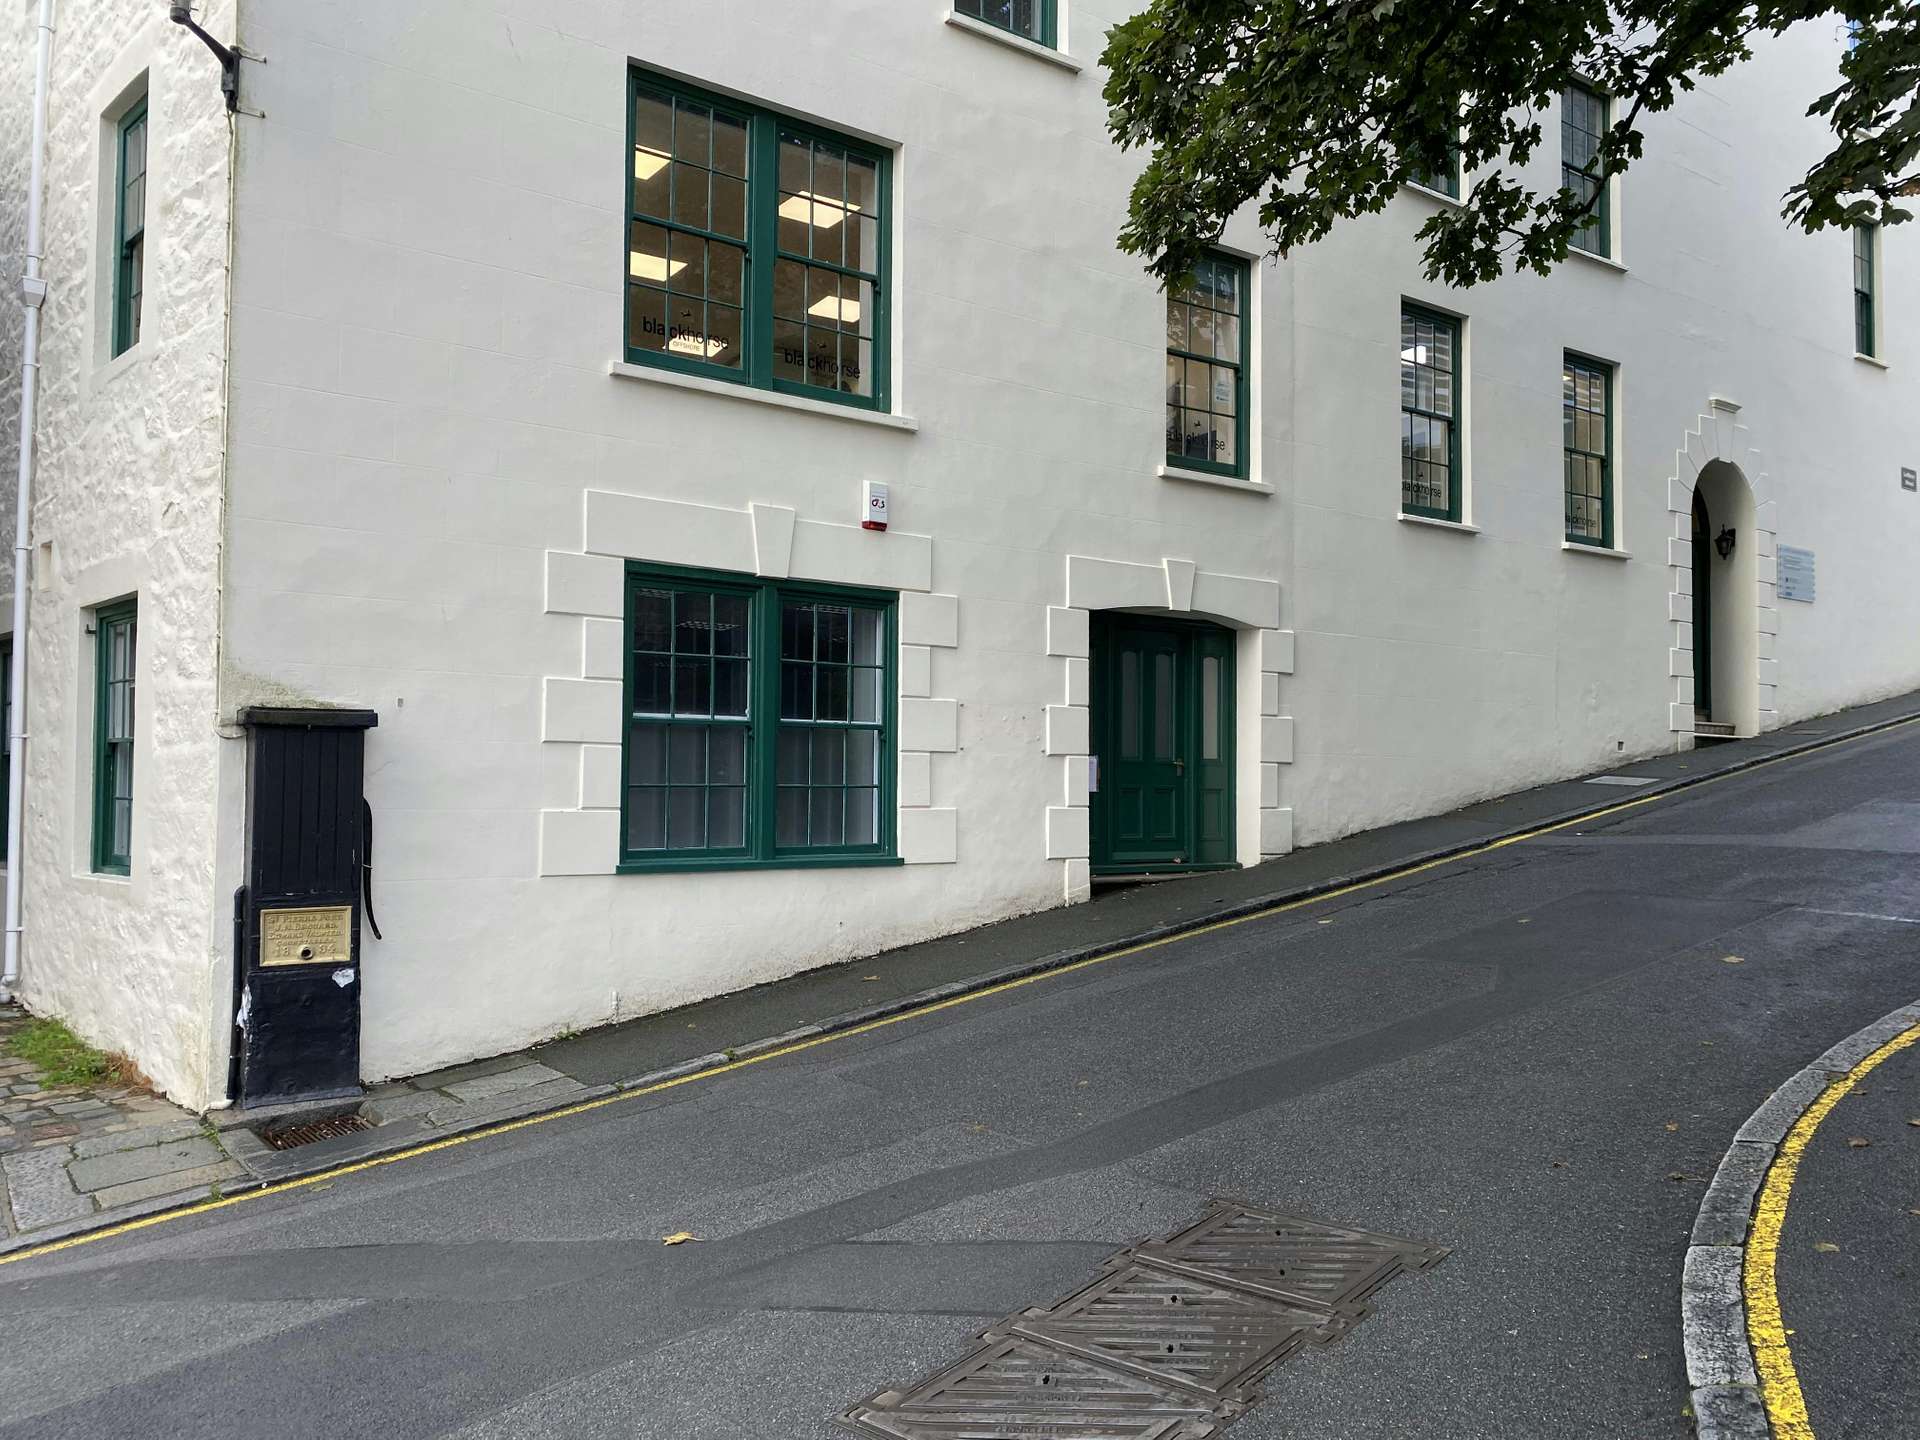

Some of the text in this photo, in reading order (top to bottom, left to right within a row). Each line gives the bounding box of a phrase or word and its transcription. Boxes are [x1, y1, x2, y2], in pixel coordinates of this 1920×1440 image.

[642, 315, 729, 350] blackhorse
[672, 340, 701, 352] OFFSHORE
[784, 348, 861, 380] blackhorse
